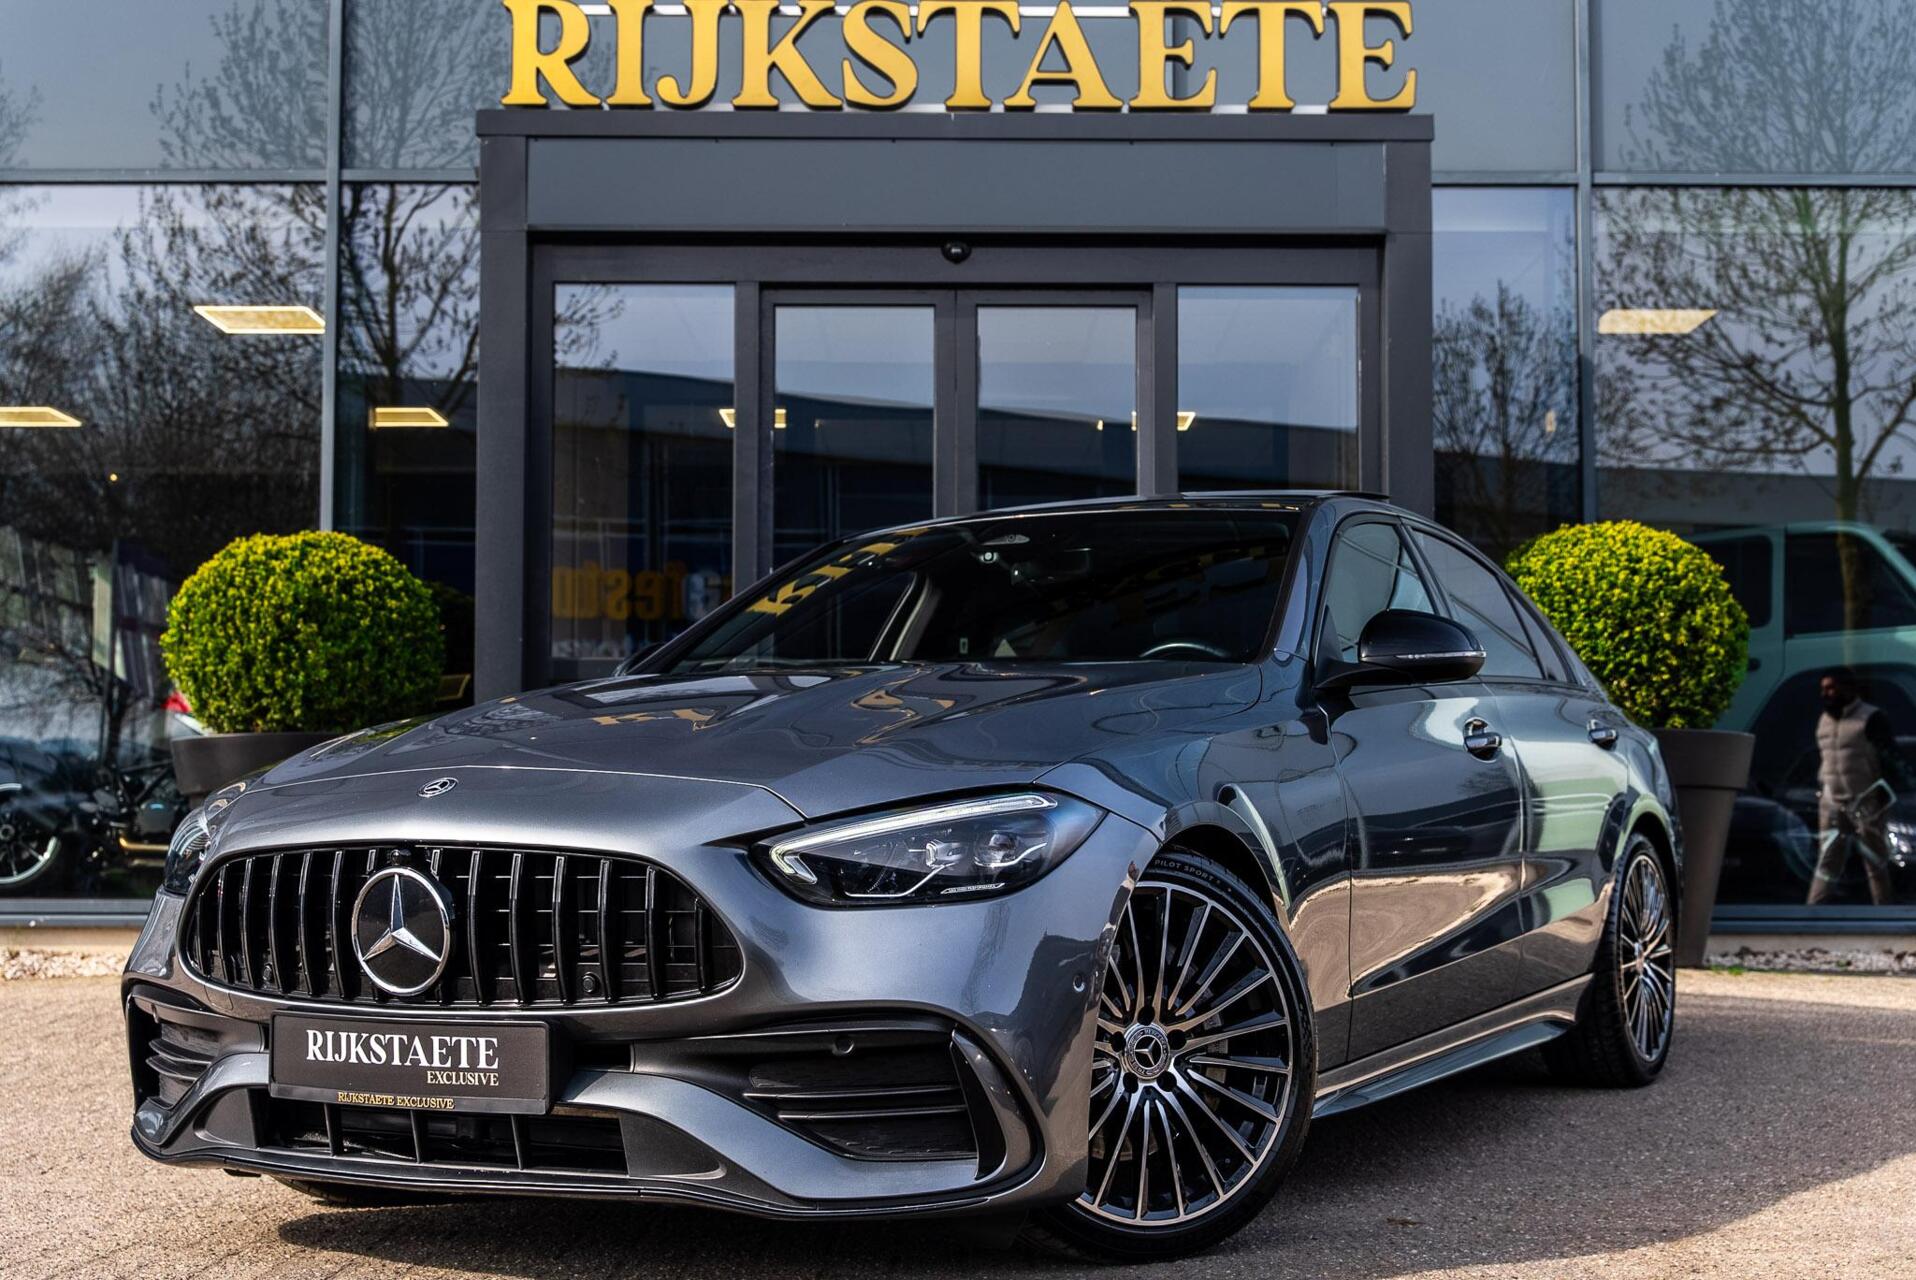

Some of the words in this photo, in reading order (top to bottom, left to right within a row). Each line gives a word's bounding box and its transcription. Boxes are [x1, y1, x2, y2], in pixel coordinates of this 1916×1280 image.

[506, 0, 1418, 112] RIJKSTAETE
[1154, 859, 1182, 869] PILOT
[1184, 865, 1215, 881] SPORT
[306, 1029, 499, 1069] RIJKSTAETE
[427, 1071, 499, 1086] EXCLUSIVE
[338, 1092, 394, 1107] RIJKSTAETE
[396, 1096, 455, 1109] EXCLUSIVE
